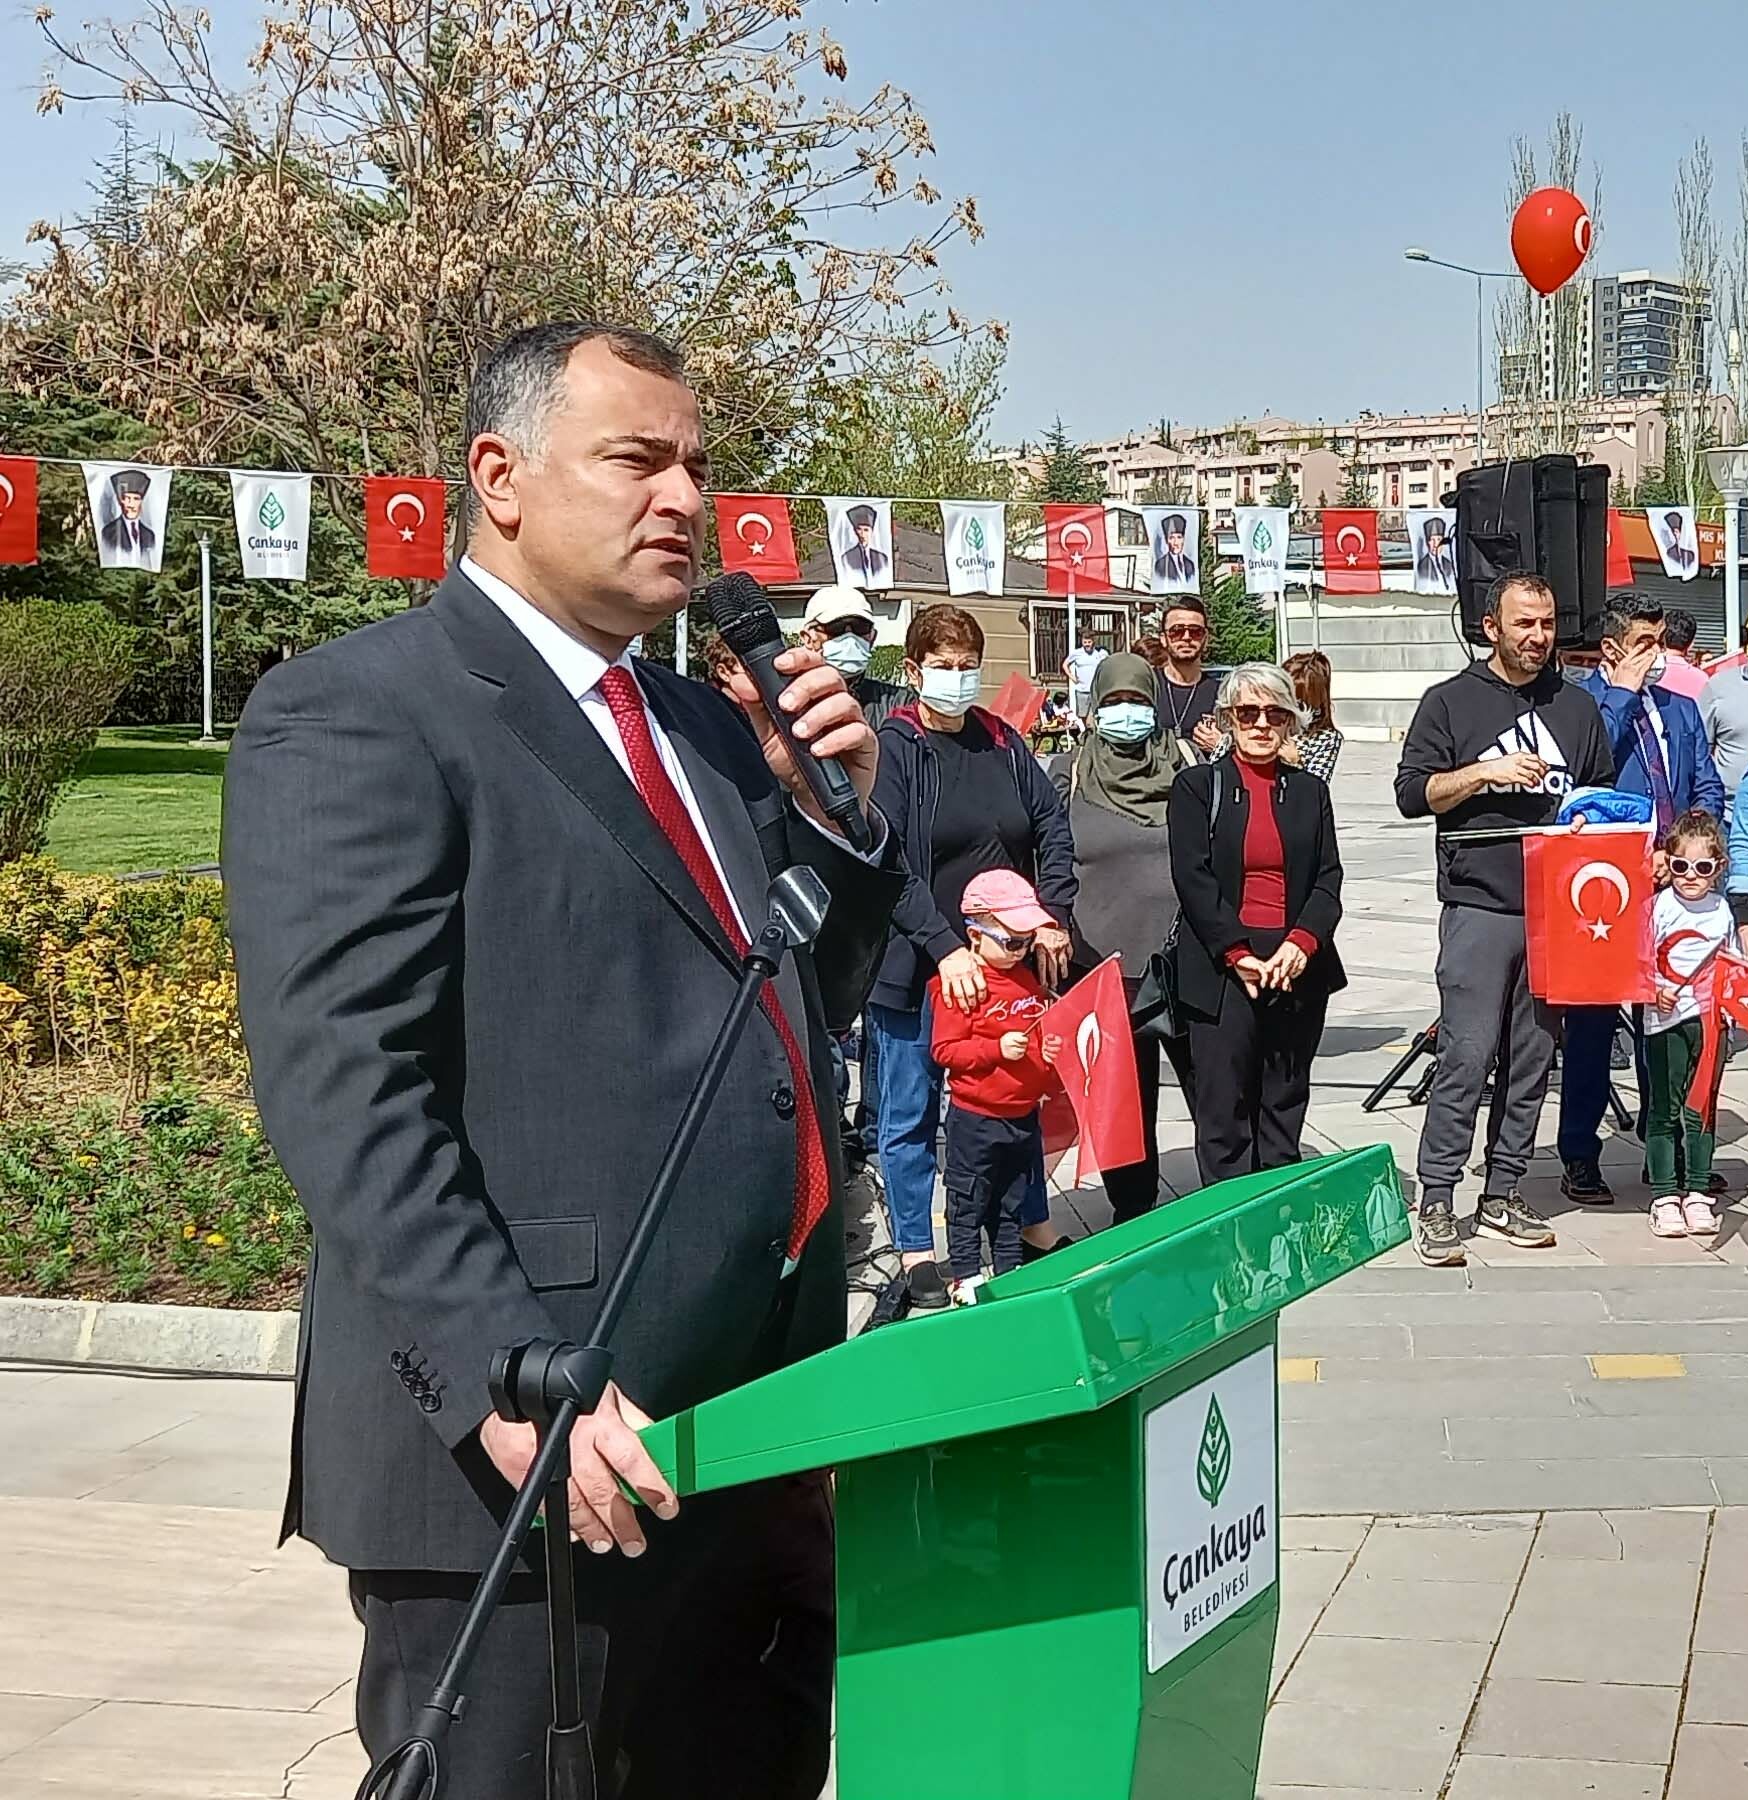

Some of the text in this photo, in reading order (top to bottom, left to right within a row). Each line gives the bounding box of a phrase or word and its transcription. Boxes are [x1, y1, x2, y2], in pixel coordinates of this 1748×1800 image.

[248, 536, 298, 551] Çankaya
[1163, 1504, 1266, 1610] Çankaya
[1184, 1565, 1249, 1633] BELEDİYESİ
